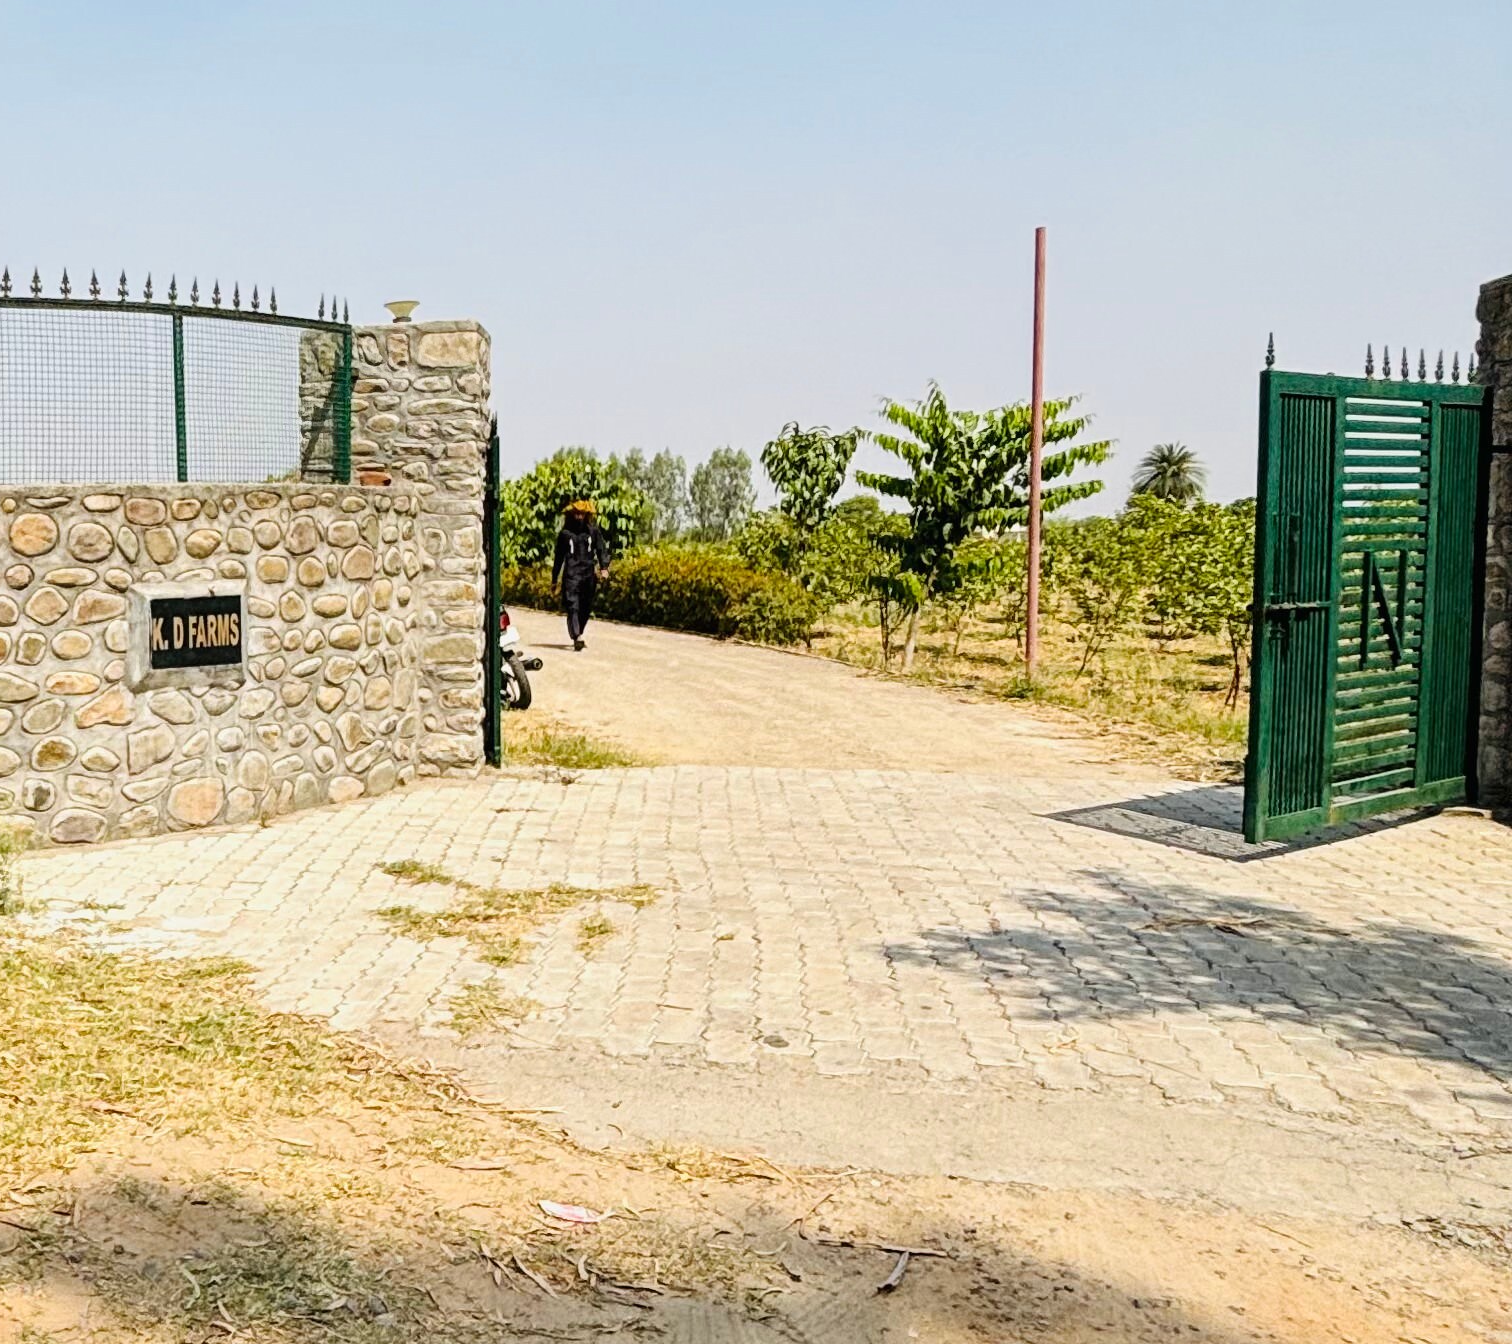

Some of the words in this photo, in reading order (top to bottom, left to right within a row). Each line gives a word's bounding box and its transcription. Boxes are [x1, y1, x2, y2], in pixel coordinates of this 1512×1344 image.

[152, 617, 170, 651] K.
[172, 615, 184, 650] D
[188, 612, 239, 649] FARMS
